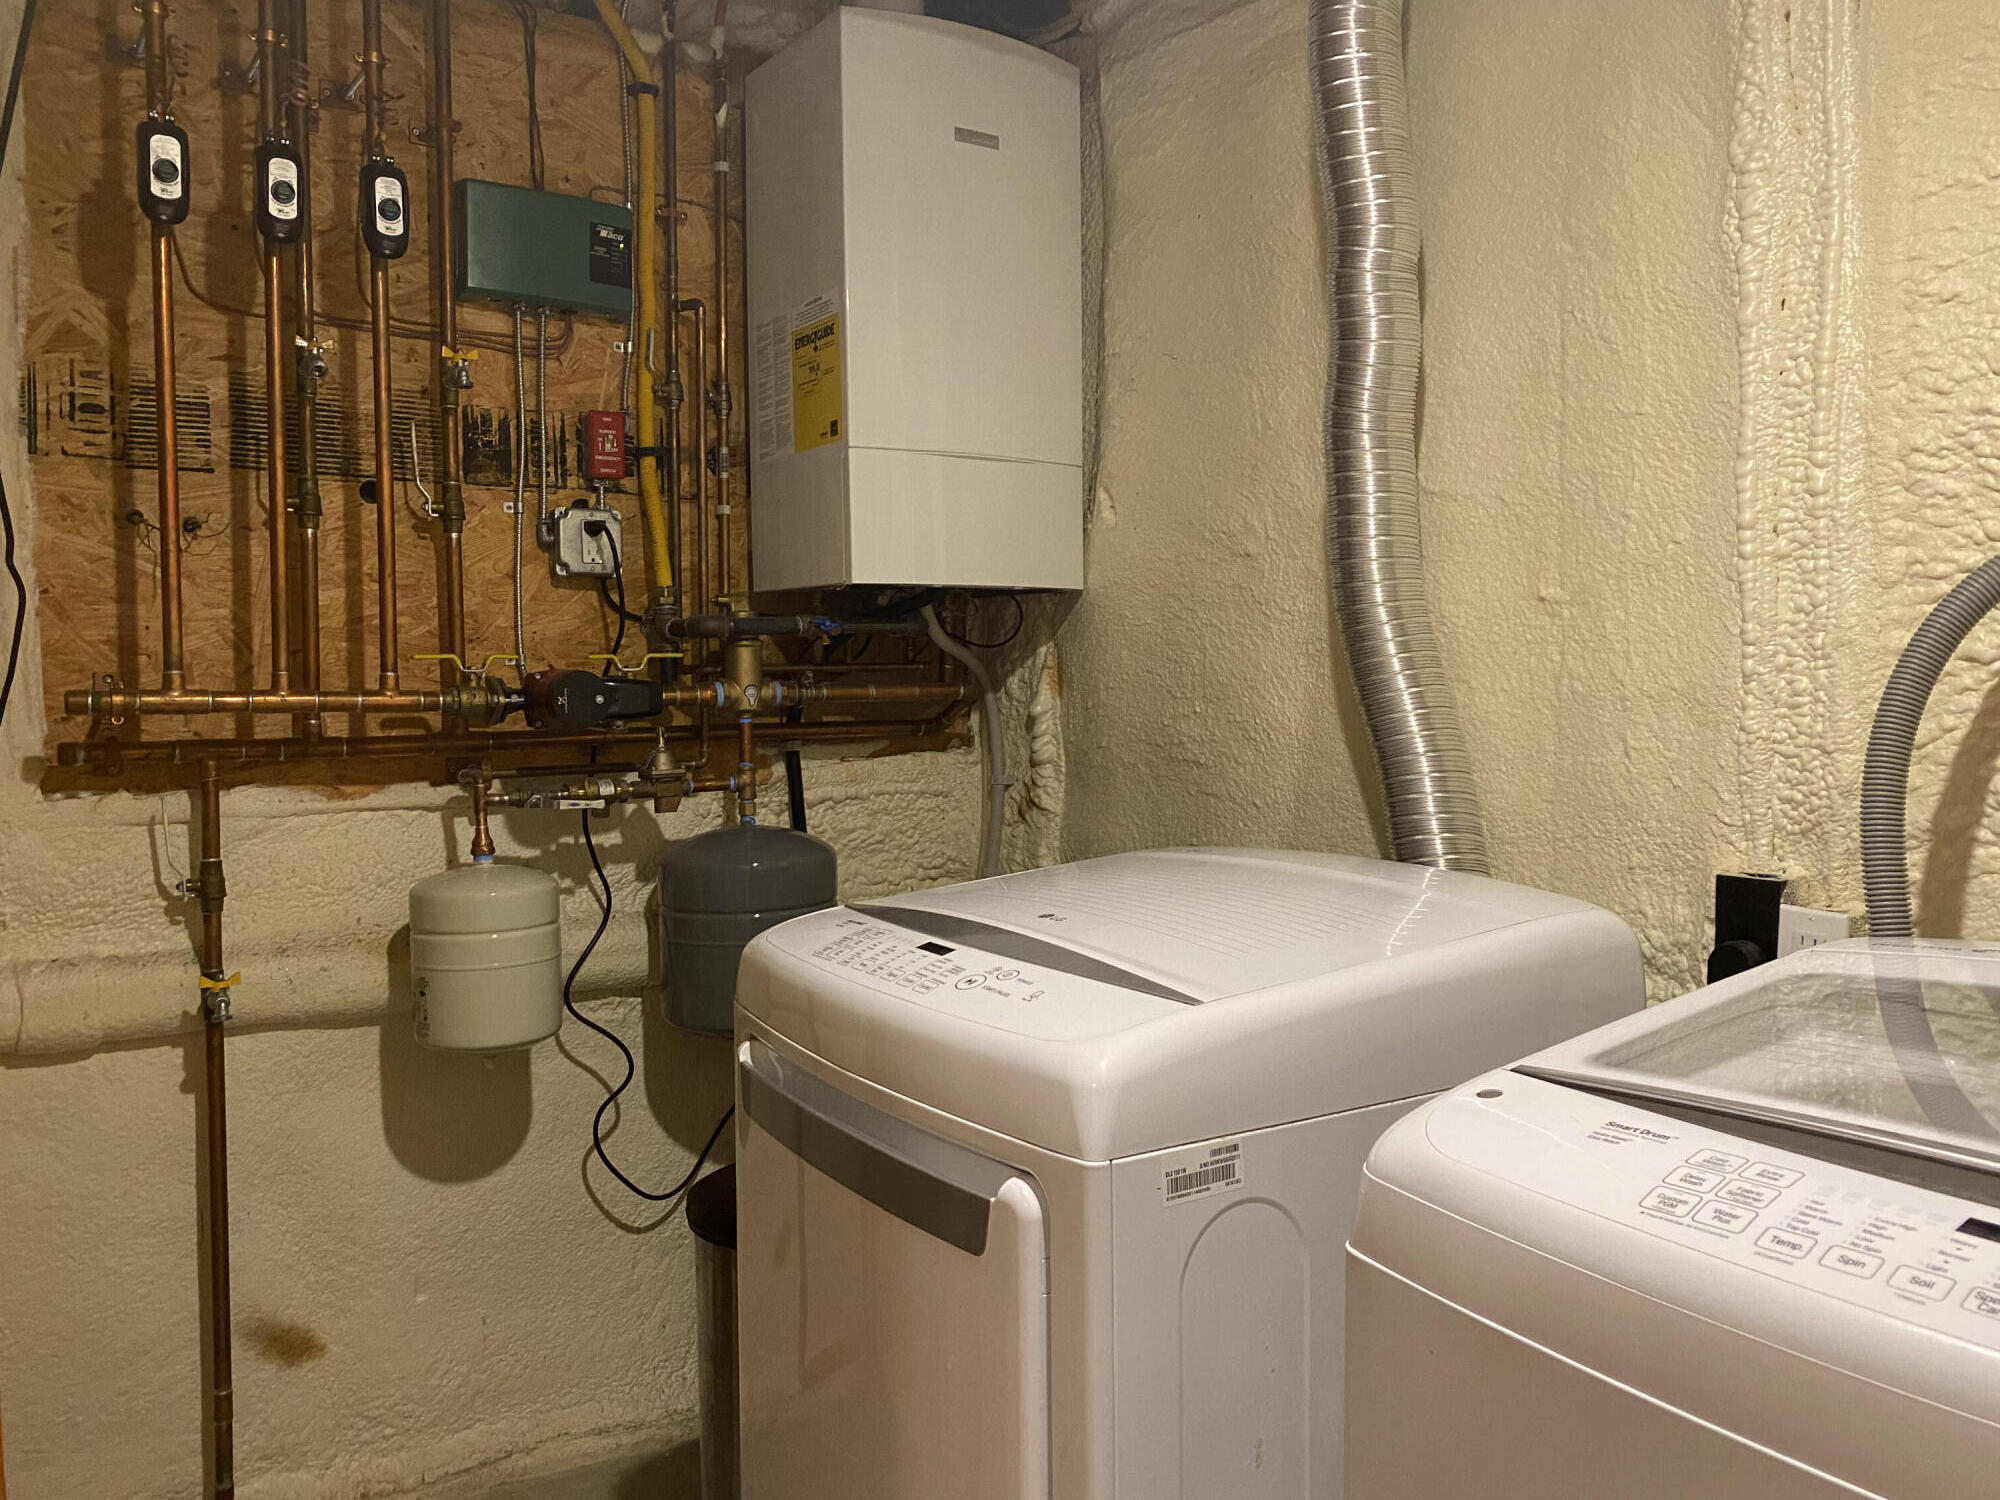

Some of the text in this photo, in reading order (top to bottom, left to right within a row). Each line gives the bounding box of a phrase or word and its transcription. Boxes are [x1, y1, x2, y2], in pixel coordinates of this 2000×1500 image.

[1605, 1120, 1639, 1133] Smart
[1640, 1127, 1671, 1141] Drum
[1657, 1192, 1689, 1206] Custom
[1714, 1207, 1742, 1221] Water
[1837, 1254, 1867, 1269] Spin
[1909, 1276, 1937, 1290] Soil
